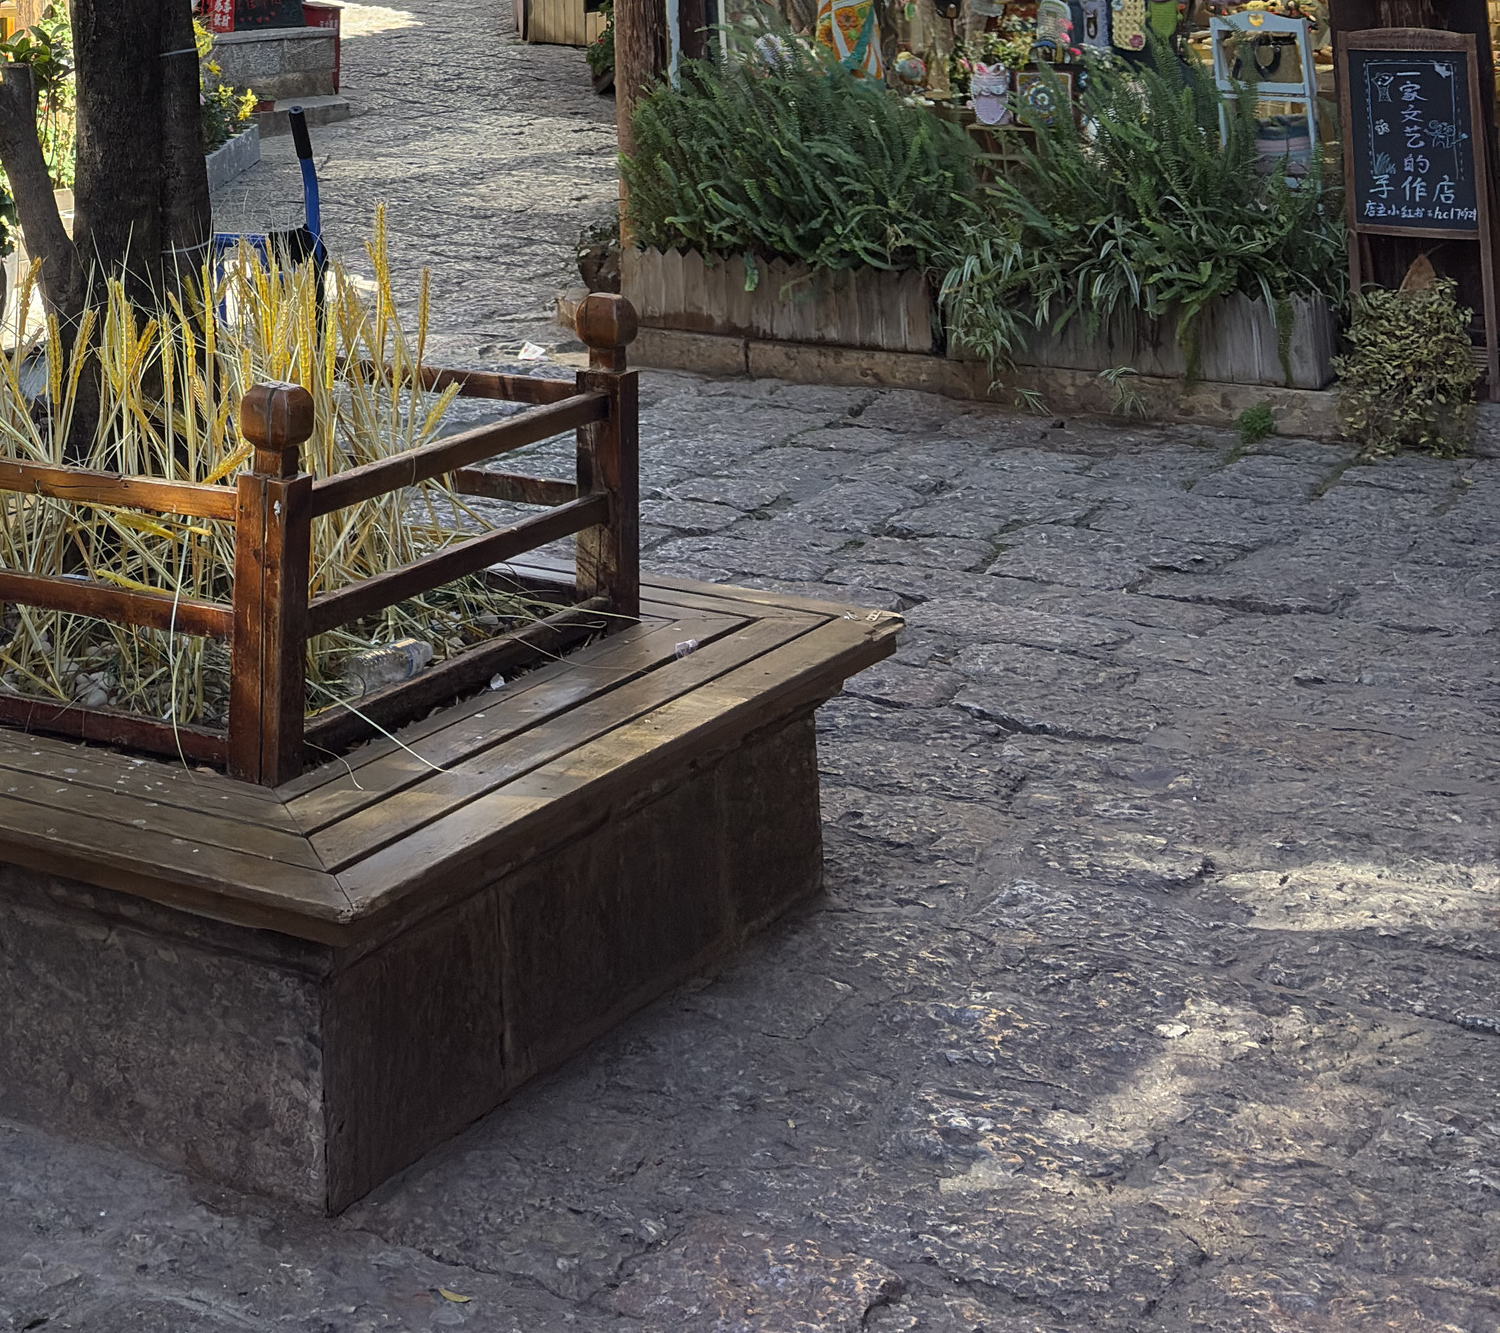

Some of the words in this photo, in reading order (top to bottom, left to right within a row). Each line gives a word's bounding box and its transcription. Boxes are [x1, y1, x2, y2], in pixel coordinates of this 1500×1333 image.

[1396, 72, 1431, 173] 一家文艺的
